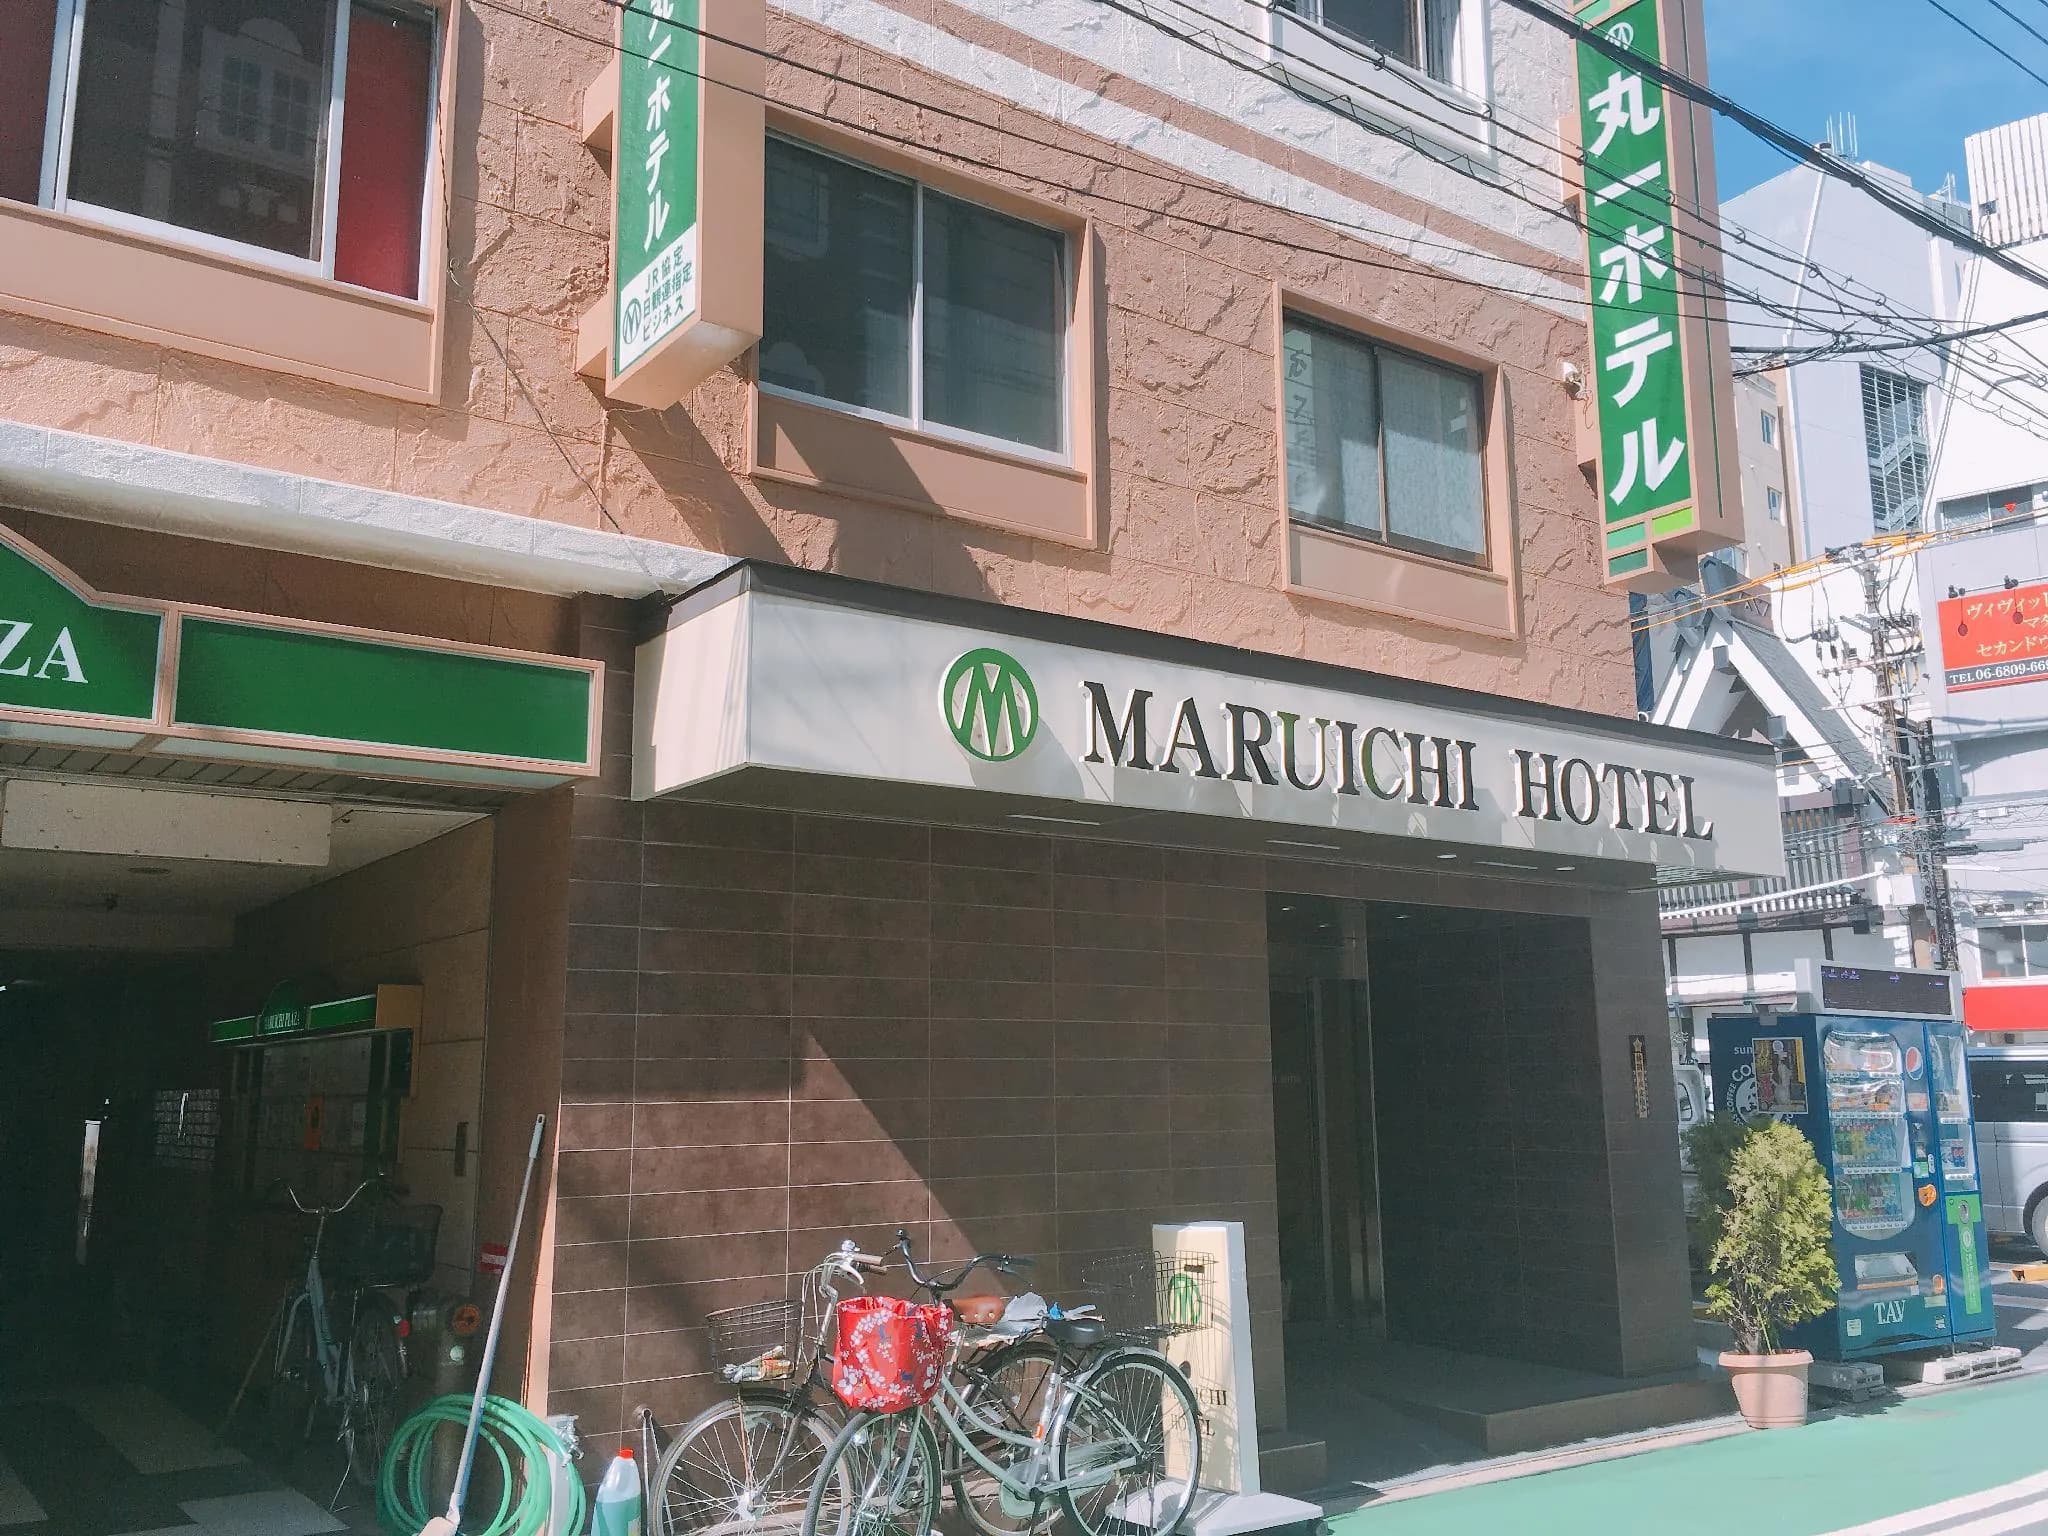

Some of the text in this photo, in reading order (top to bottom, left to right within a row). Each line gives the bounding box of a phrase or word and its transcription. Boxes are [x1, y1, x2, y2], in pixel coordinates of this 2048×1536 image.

[642, 294, 684, 342] ビジネス
[1588, 70, 1686, 506] 丸一ホテル
[1949, 672, 1975, 684] TEL
[1077, 679, 1714, 841] MARUICHI HOTEL
